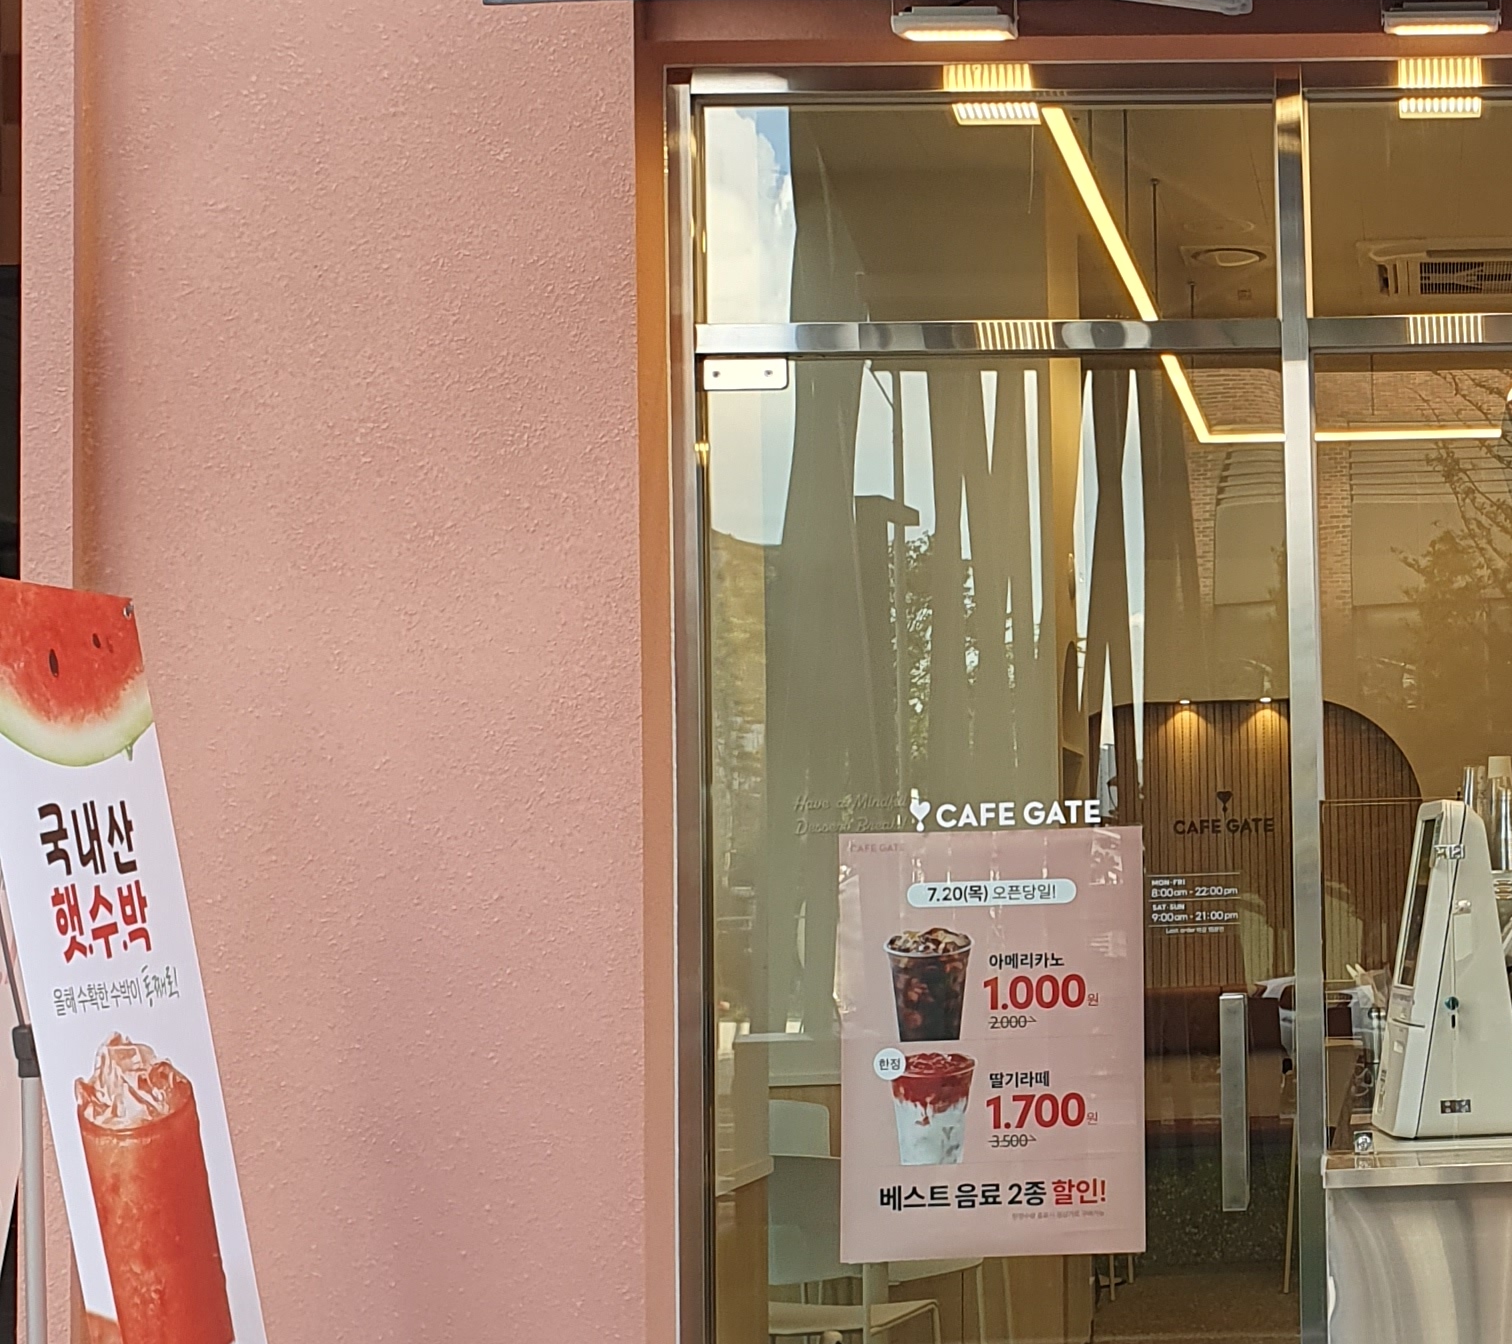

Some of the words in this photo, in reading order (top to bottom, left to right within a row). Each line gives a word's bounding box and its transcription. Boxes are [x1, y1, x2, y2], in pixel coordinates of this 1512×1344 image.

[936, 803, 1016, 828] CAFE
[1023, 799, 1101, 825] GATE
[1173, 819, 1222, 835] CAFE
[1226, 817, 1275, 834] GATE
[37, 799, 138, 877] 국내산
[926, 884, 989, 904] 7.20(목)
[991, 883, 1057, 901] 오픈당일!
[988, 952, 1065, 970] 아메리카노
[53, 985, 78, 1017] 올해
[77, 982, 110, 1013] 수확한
[109, 977, 143, 1008] 수박이
[879, 1058, 901, 1072] 한정
[988, 1070, 1051, 1089] 딸기라떼
[879, 1184, 951, 1212] 베스트
[954, 1183, 1003, 1209] 음료
[1007, 1181, 1047, 1207] 2종
[1051, 1178, 1107, 1206] 할인!
